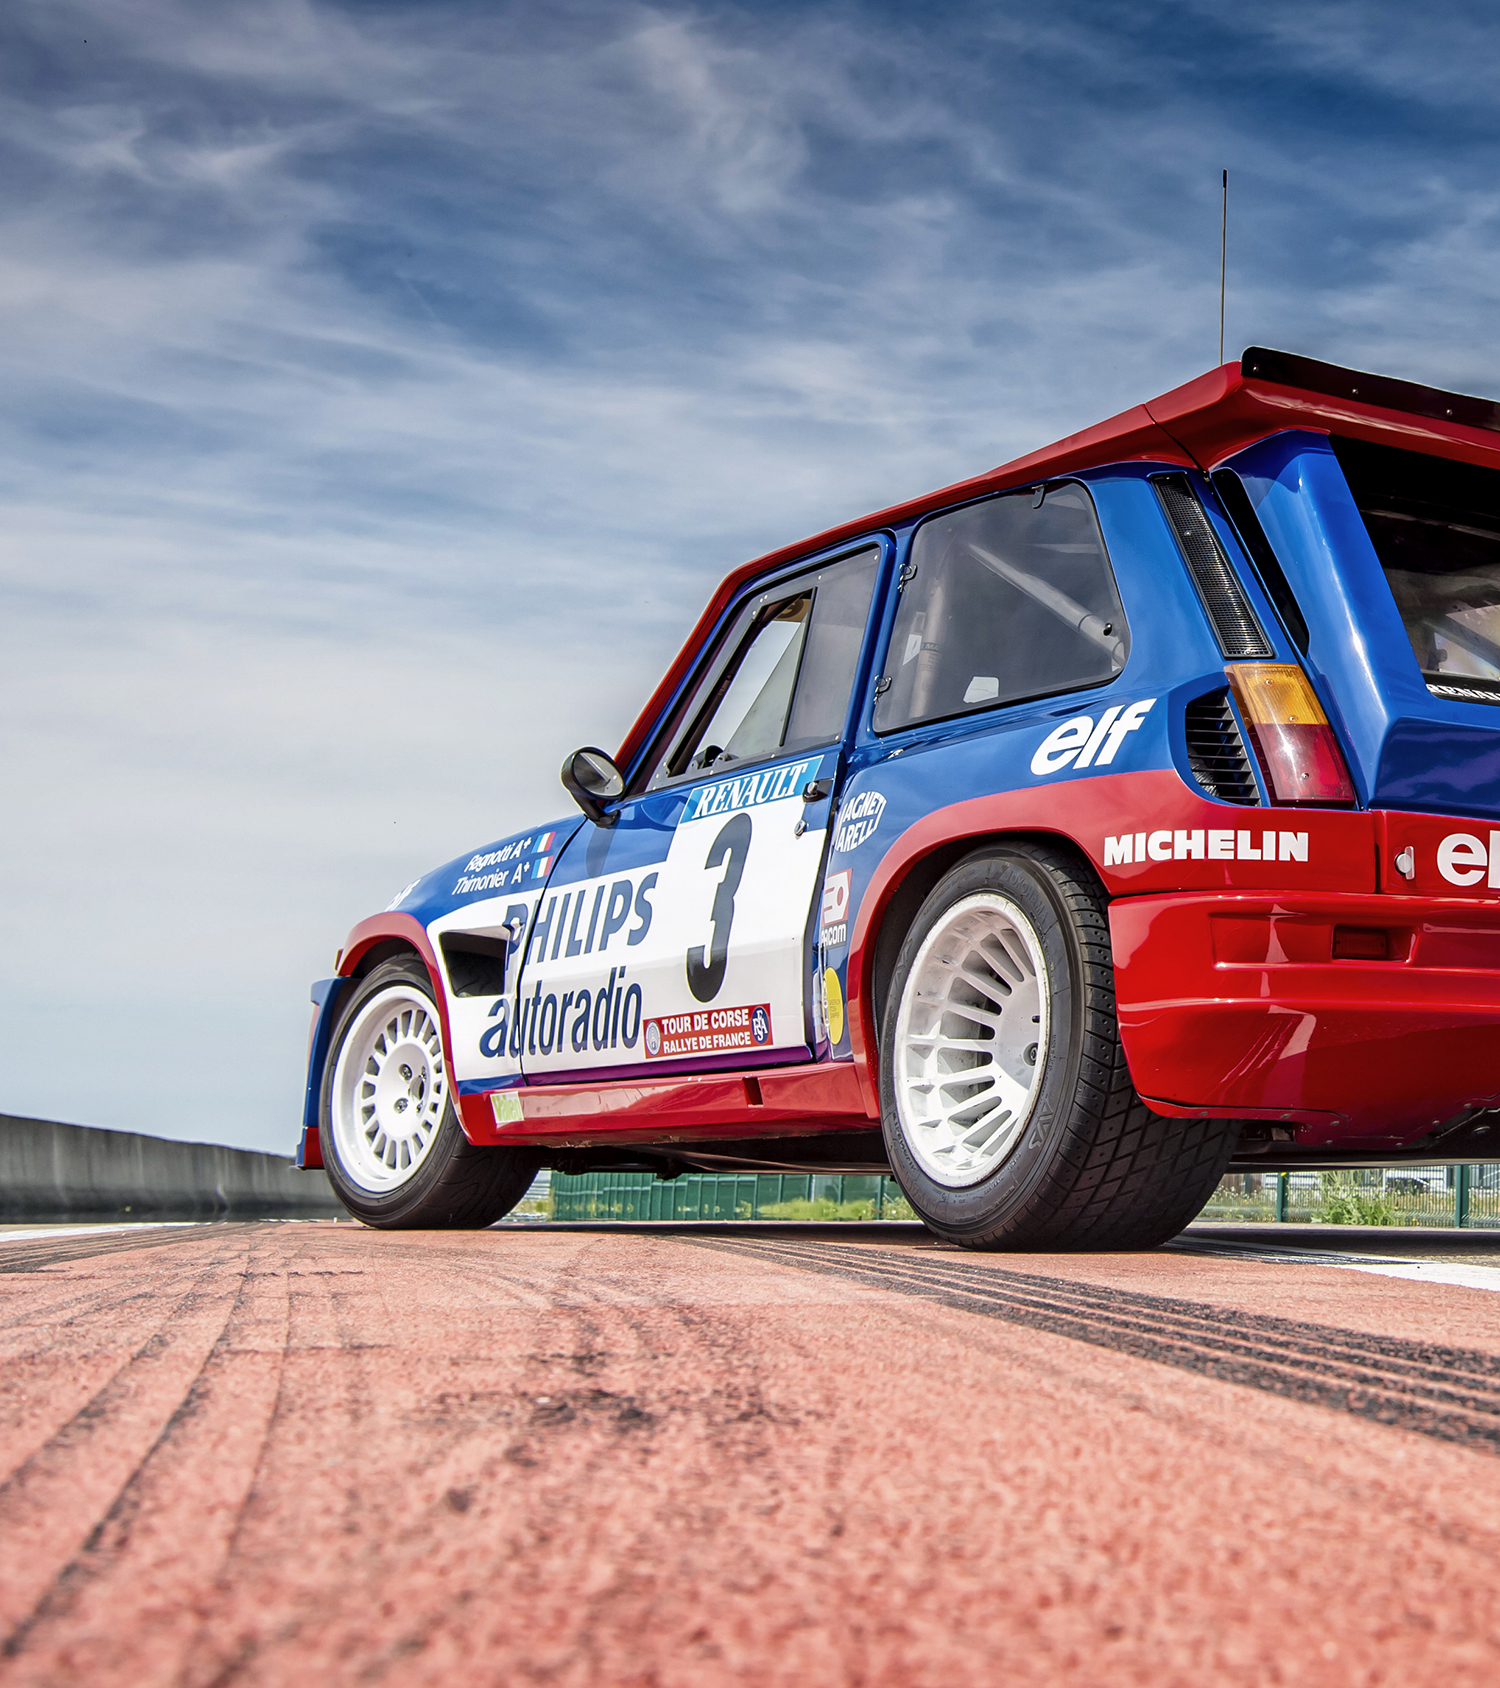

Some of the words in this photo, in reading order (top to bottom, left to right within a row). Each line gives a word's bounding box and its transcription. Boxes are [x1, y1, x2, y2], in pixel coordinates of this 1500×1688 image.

[1030, 697, 1157, 776] elf
[691, 762, 809, 820] RENAULT
[1103, 829, 1309, 867] MICHELIN
[451, 869, 509, 896] Thimonier
[686, 812, 753, 1004] 3
[502, 871, 660, 972] PHILIPS
[478, 965, 643, 1059] autoradio
[661, 1016, 692, 1036] TOUR
[693, 1013, 709, 1031] DE
[710, 1008, 750, 1029] CORSE
[662, 1037, 698, 1054] RALLYE
[699, 1036, 712, 1049] DE
[713, 1031, 752, 1047] FRANCE
